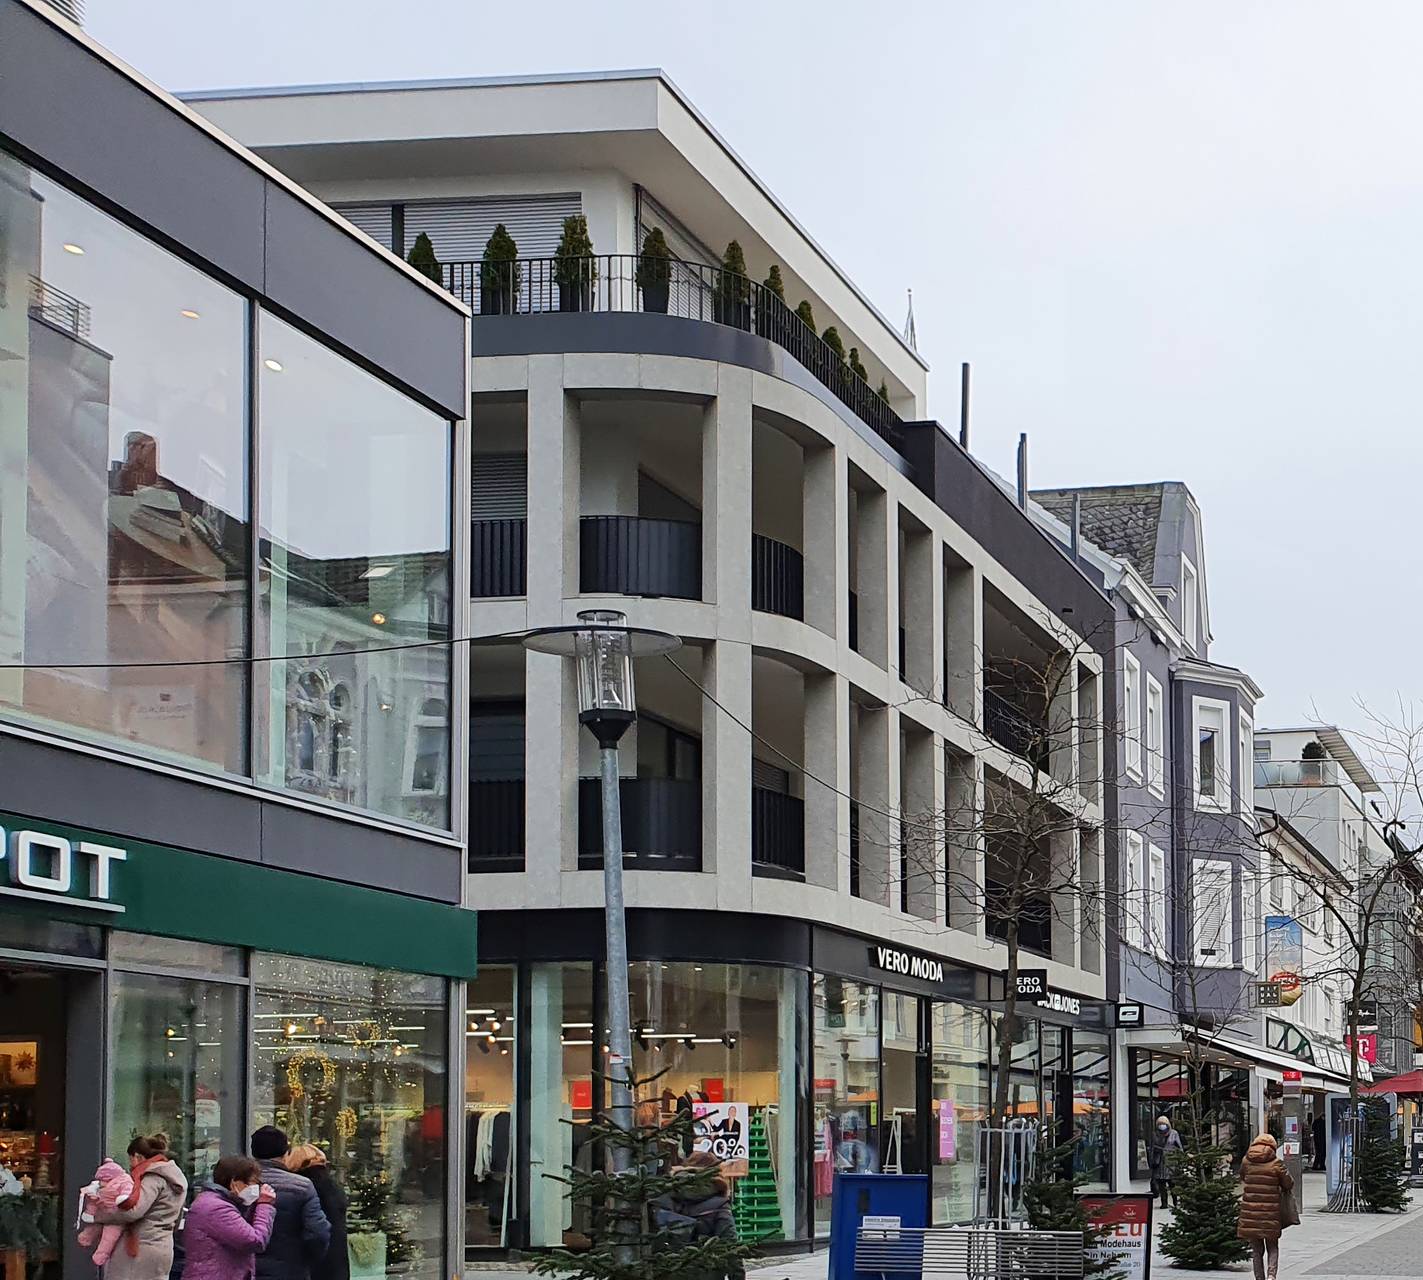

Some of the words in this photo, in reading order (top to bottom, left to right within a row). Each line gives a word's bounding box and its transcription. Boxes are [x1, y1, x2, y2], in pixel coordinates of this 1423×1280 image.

[0, 825, 127, 899] OT
[878, 946, 909, 974] VERO
[910, 956, 944, 982] MODA
[1016, 977, 1040, 985] ERO
[1017, 985, 1042, 993] ODA
